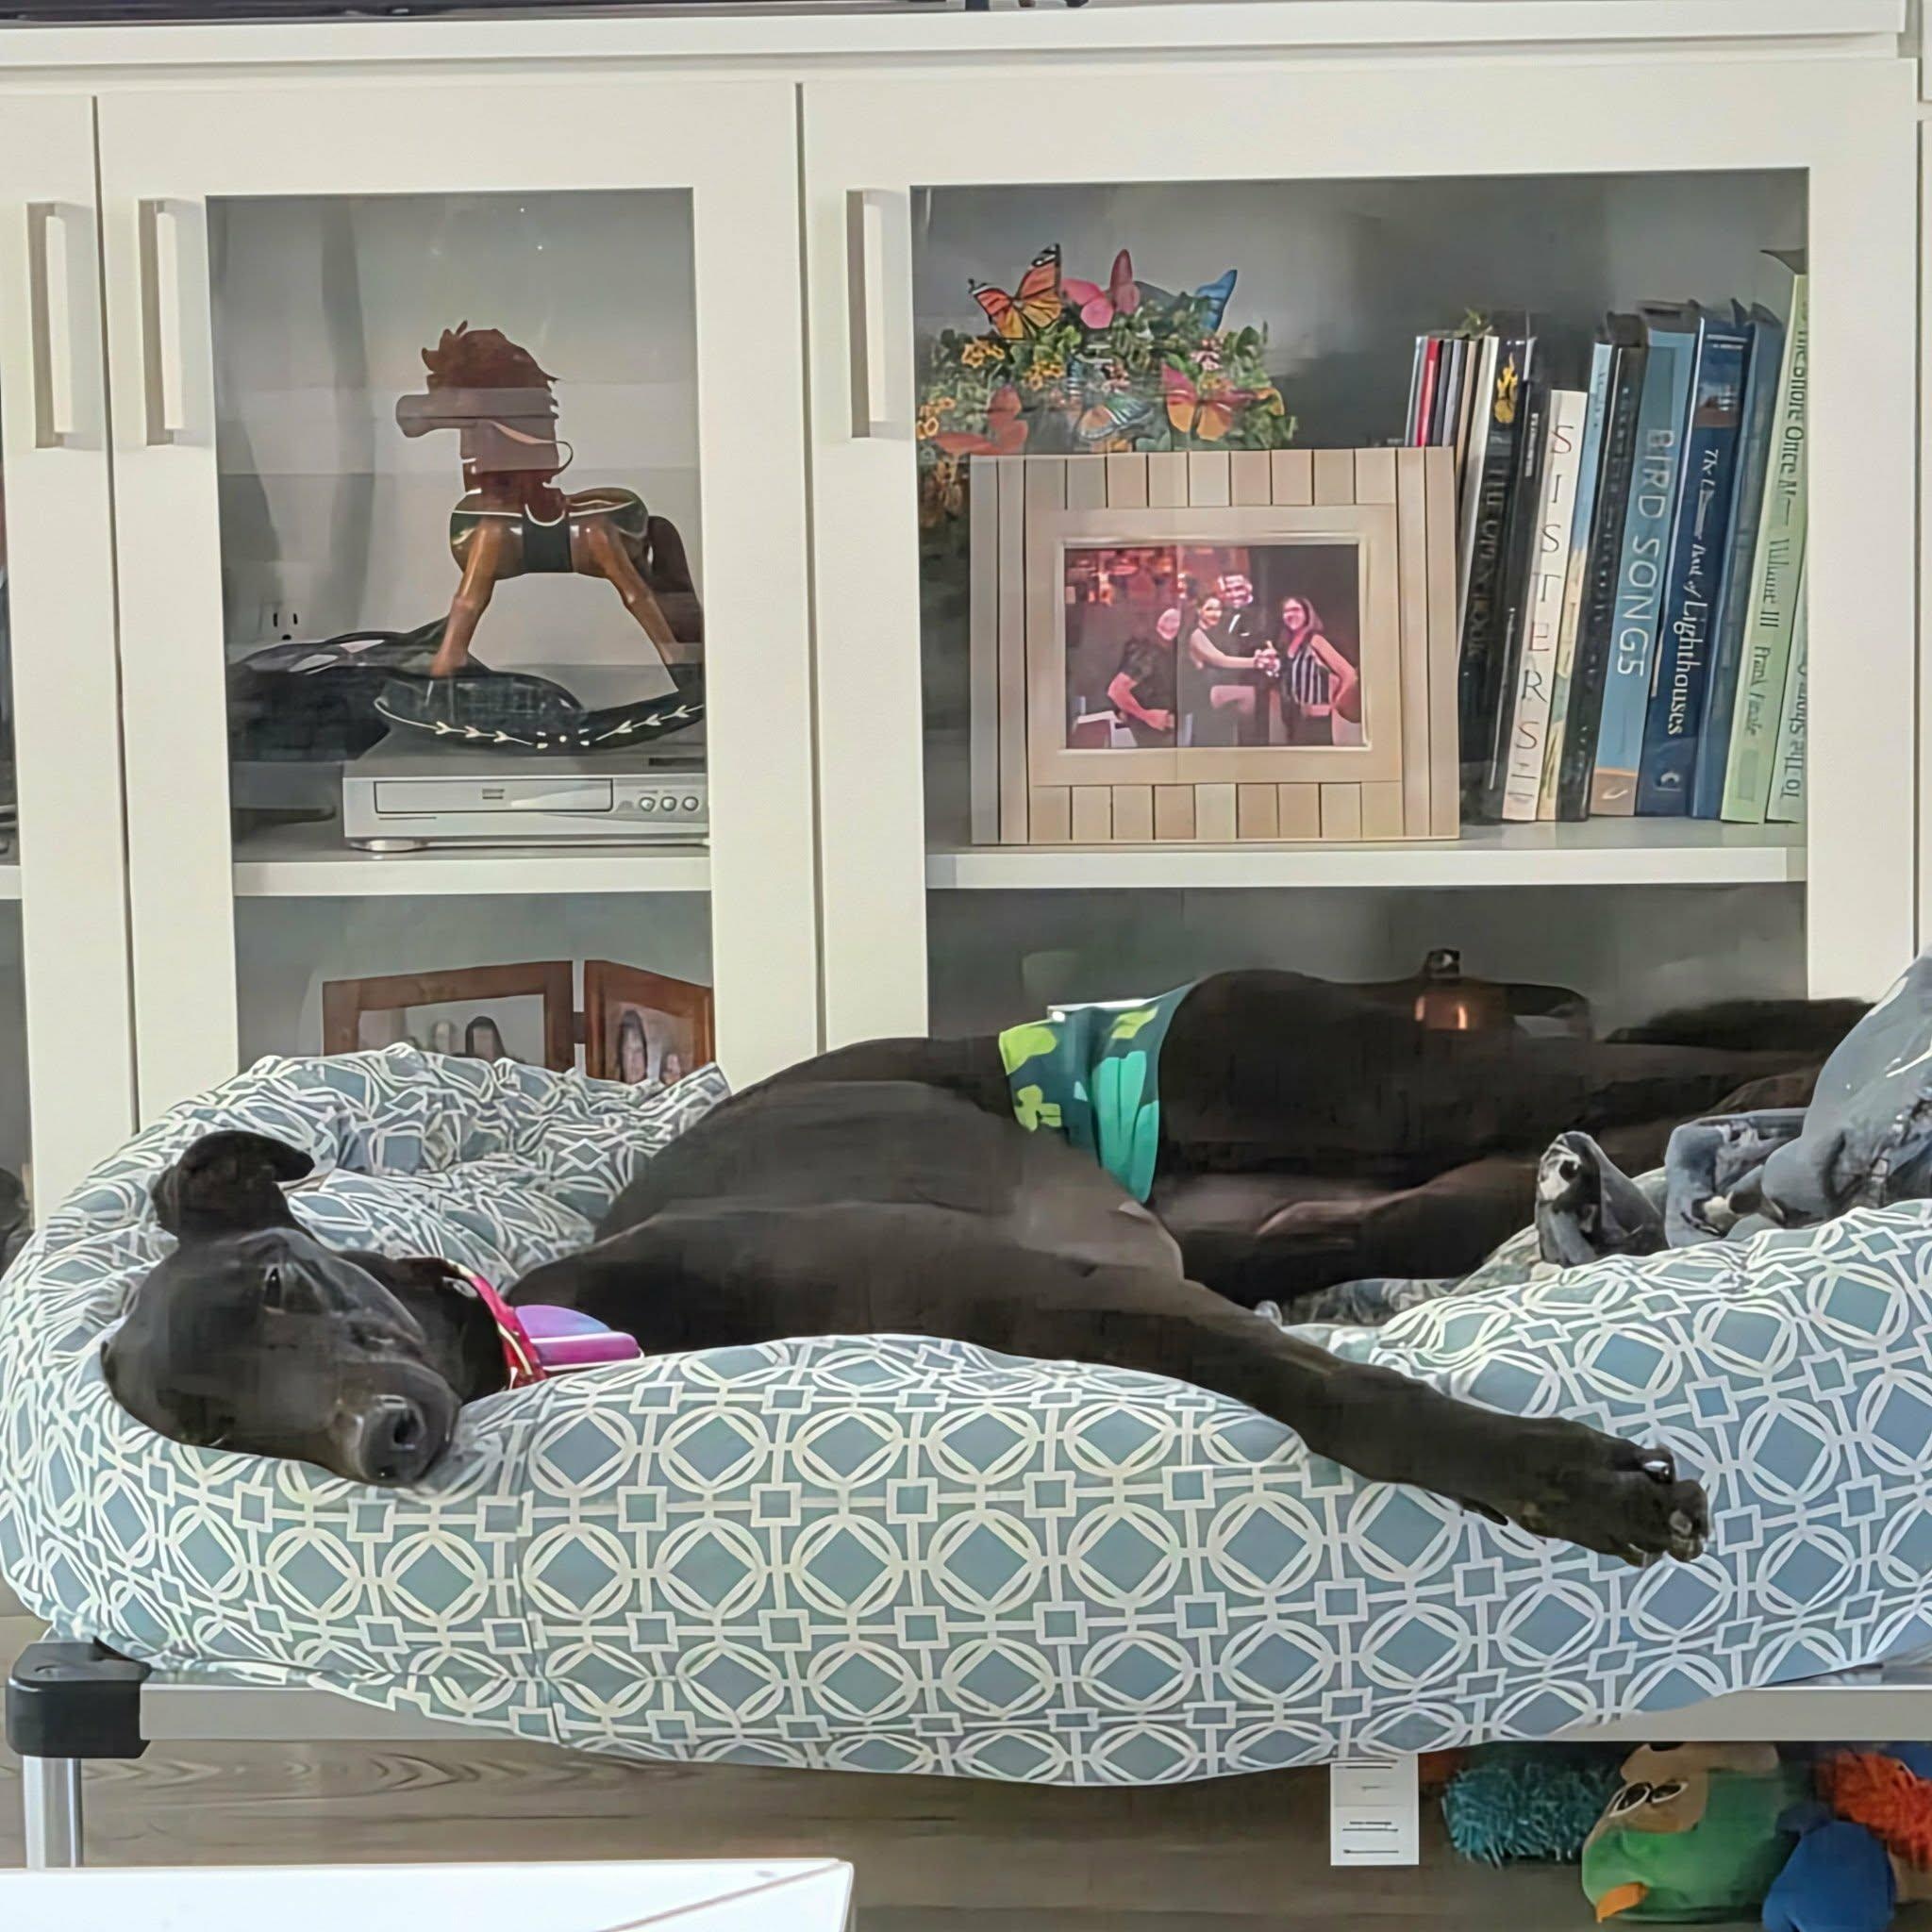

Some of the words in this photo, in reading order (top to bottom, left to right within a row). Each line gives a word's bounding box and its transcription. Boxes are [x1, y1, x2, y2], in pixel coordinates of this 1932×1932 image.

[1637, 429, 1675, 519] BIRD
[1513, 425, 1574, 751] SISTERS
[1617, 535, 1660, 677] SONGS
[1759, 610, 1780, 627] III
[1667, 600, 1708, 736] Lighthouses
[1780, 778, 1801, 800] To
